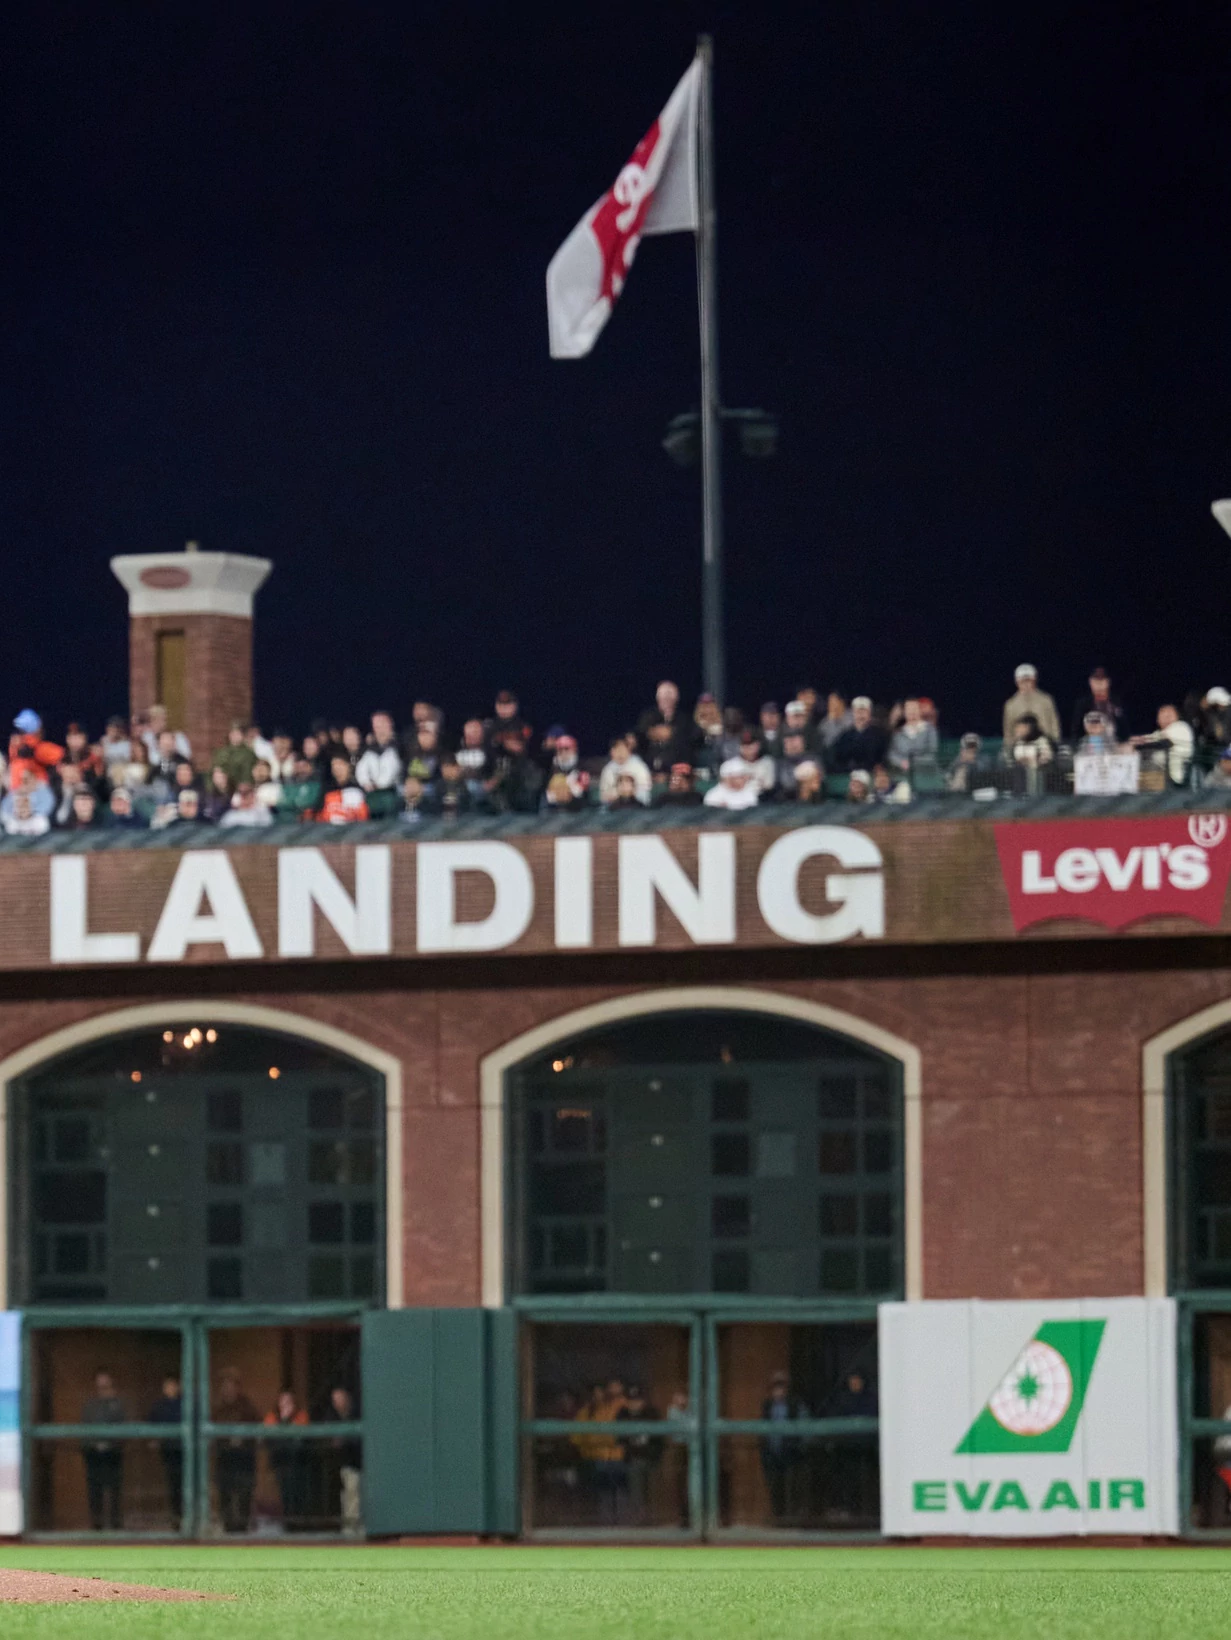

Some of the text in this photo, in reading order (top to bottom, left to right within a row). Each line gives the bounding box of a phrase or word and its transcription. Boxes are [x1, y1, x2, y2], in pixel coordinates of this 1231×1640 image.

[50, 825, 886, 963] LANDING
[913, 1479, 1146, 1511] EVA AIR
